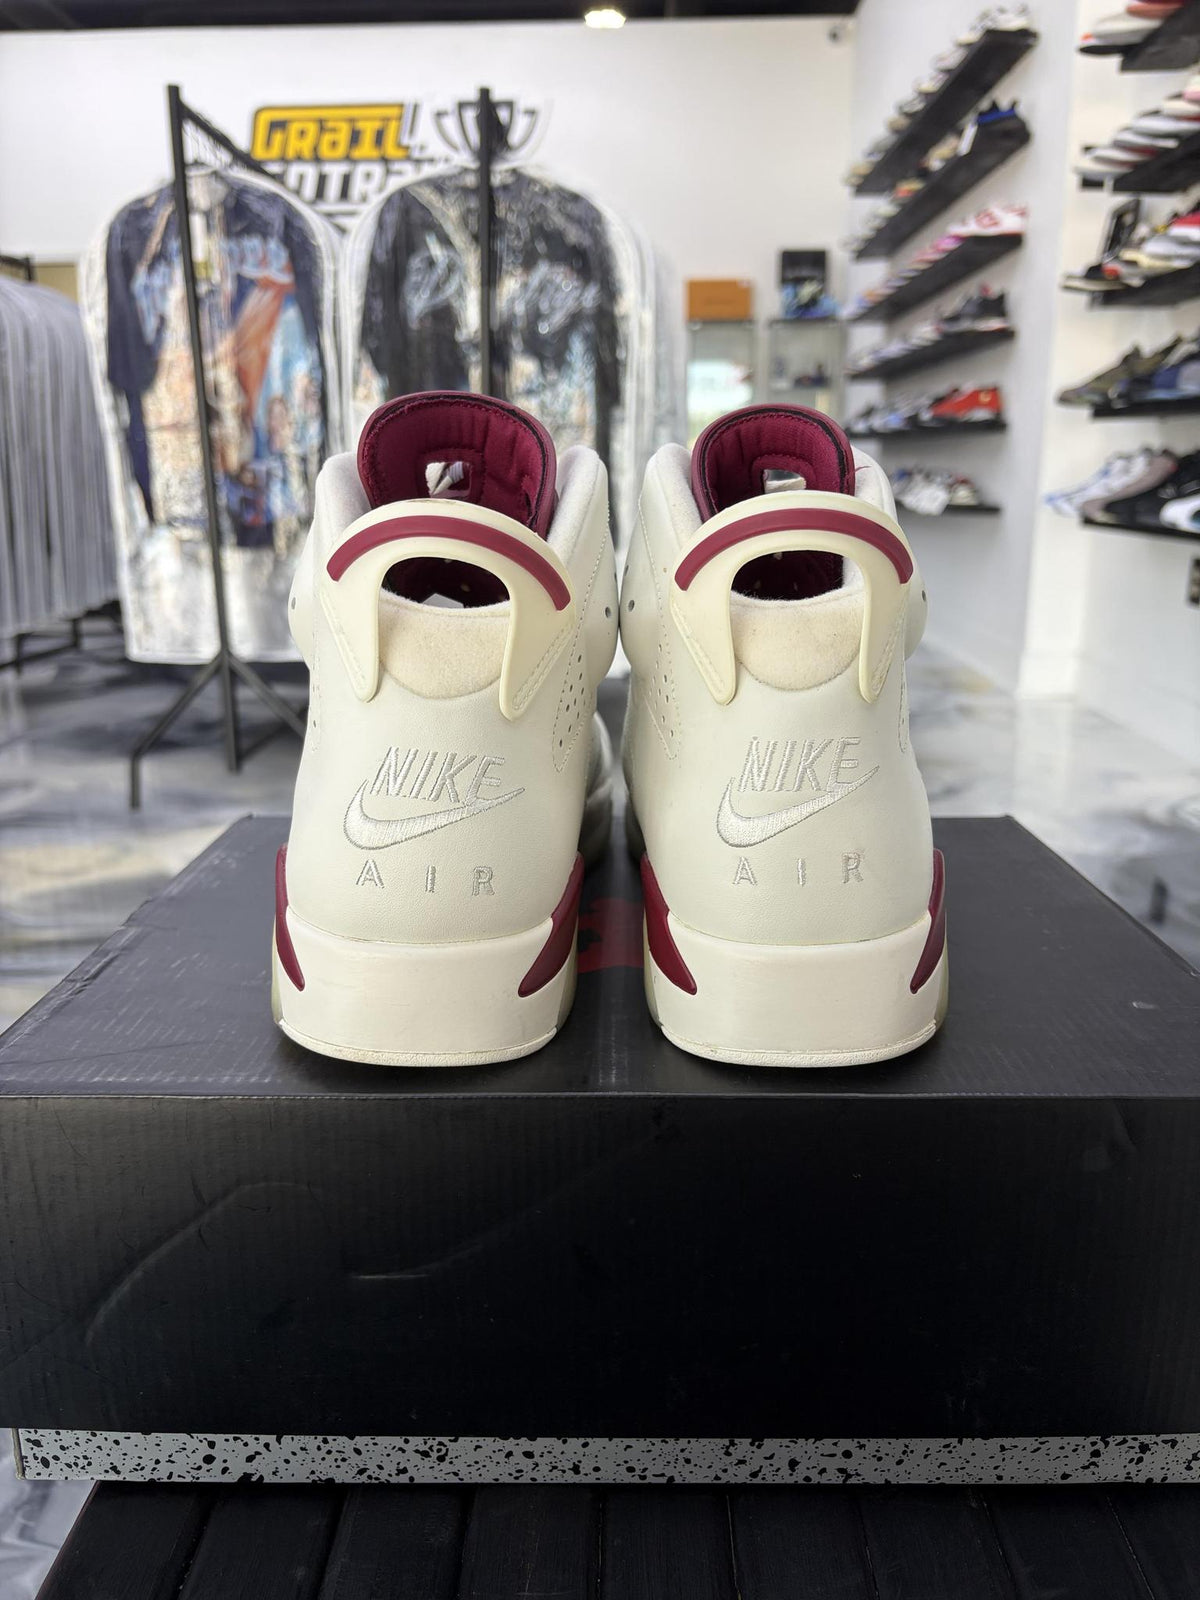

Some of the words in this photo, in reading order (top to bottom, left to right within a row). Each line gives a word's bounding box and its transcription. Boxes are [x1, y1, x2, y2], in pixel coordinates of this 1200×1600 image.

[369, 746, 505, 806] NIKE
[737, 736, 861, 793] NIKE
[356, 858, 495, 897] AIR
[732, 852, 864, 887] AIR
